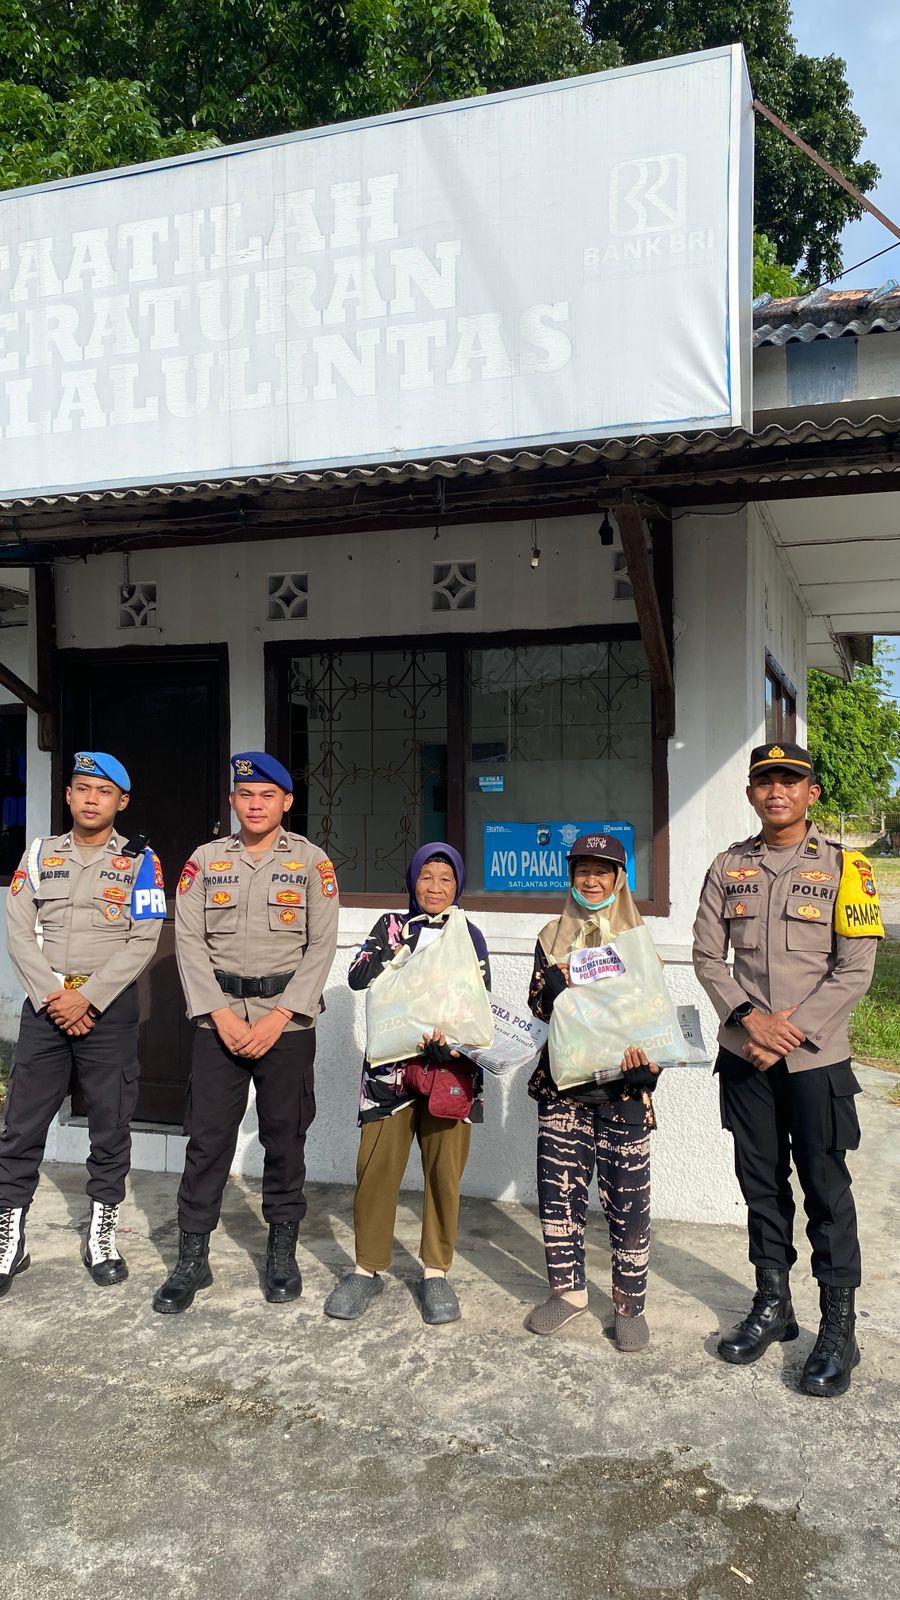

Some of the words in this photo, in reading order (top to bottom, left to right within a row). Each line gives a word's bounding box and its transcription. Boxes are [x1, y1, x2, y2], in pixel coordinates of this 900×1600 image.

[0, 173, 399, 303] AATILAH
[583, 236, 663, 267] BANK
[669, 228, 714, 254] BRI
[490, 850, 517, 878] AYO
[521, 850, 563, 878] PAKAI
[99, 870, 134, 884] POLRI
[271, 873, 307, 885] POLRI
[725, 883, 759, 896] BAGAS
[791, 884, 834, 900] POLRI
[512, 1015, 533, 1032] POS
